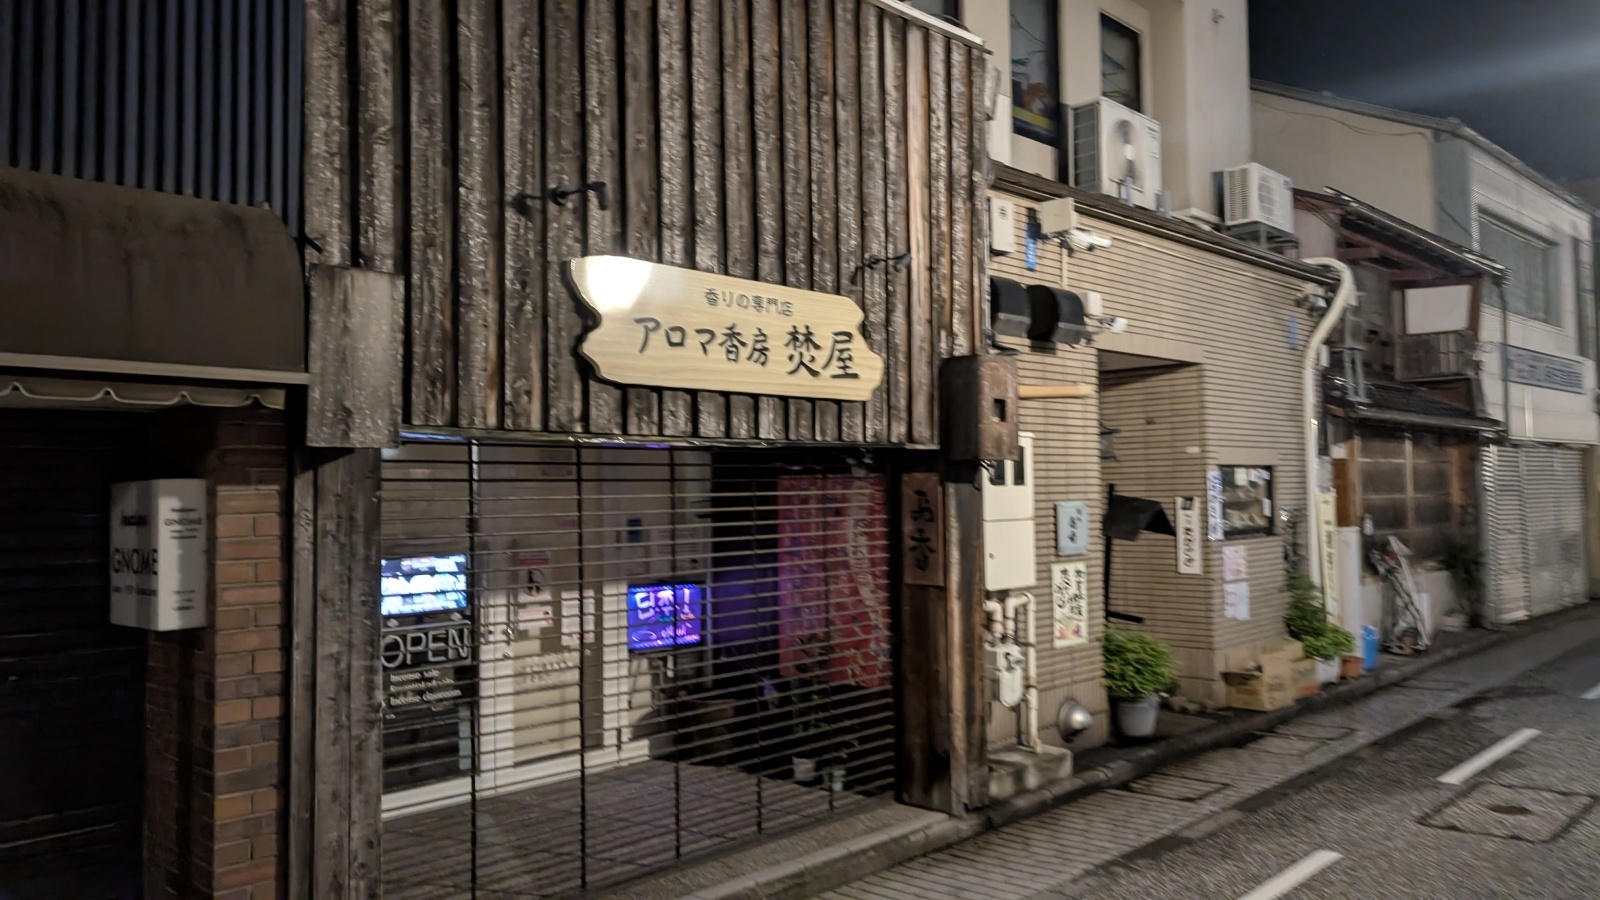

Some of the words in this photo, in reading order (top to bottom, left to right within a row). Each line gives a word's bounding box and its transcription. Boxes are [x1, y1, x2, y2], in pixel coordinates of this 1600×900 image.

[703, 287, 793, 317] 香りの専門店
[633, 316, 771, 367] アロマ香房
[783, 323, 860, 380] 焚屋
[112, 548, 158, 576] GNOME
[381, 628, 468, 668] OPEN
